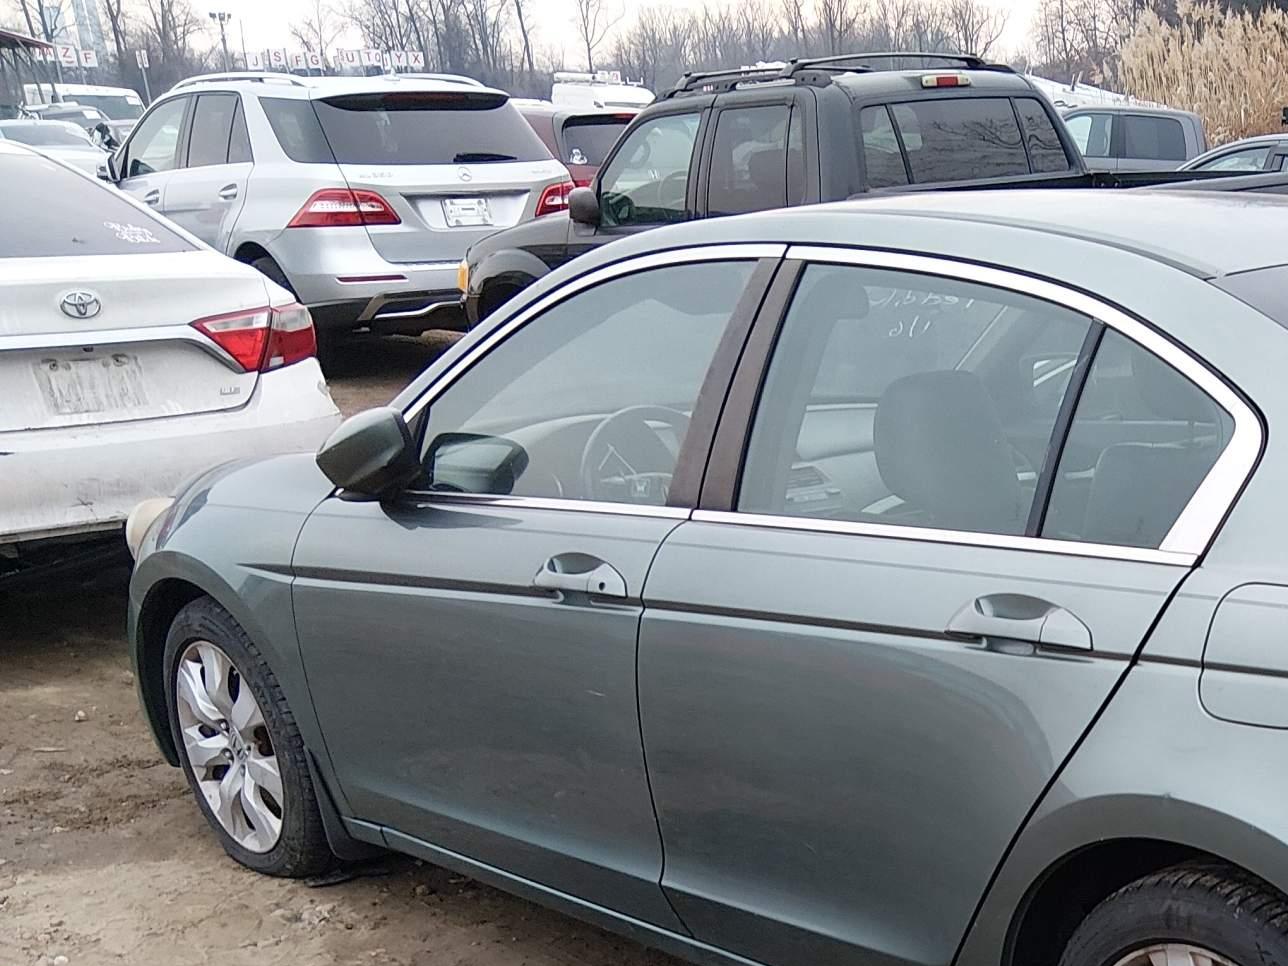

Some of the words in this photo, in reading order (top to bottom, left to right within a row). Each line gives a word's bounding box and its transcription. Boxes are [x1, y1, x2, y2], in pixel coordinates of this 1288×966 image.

[62, 48, 73, 59] Z
[84, 52, 93, 63] F
[273, 51, 282, 62] S
[345, 52, 354, 63] U
[394, 53, 403, 63] Y
[412, 53, 421, 64] X
[310, 54, 319, 66] G
